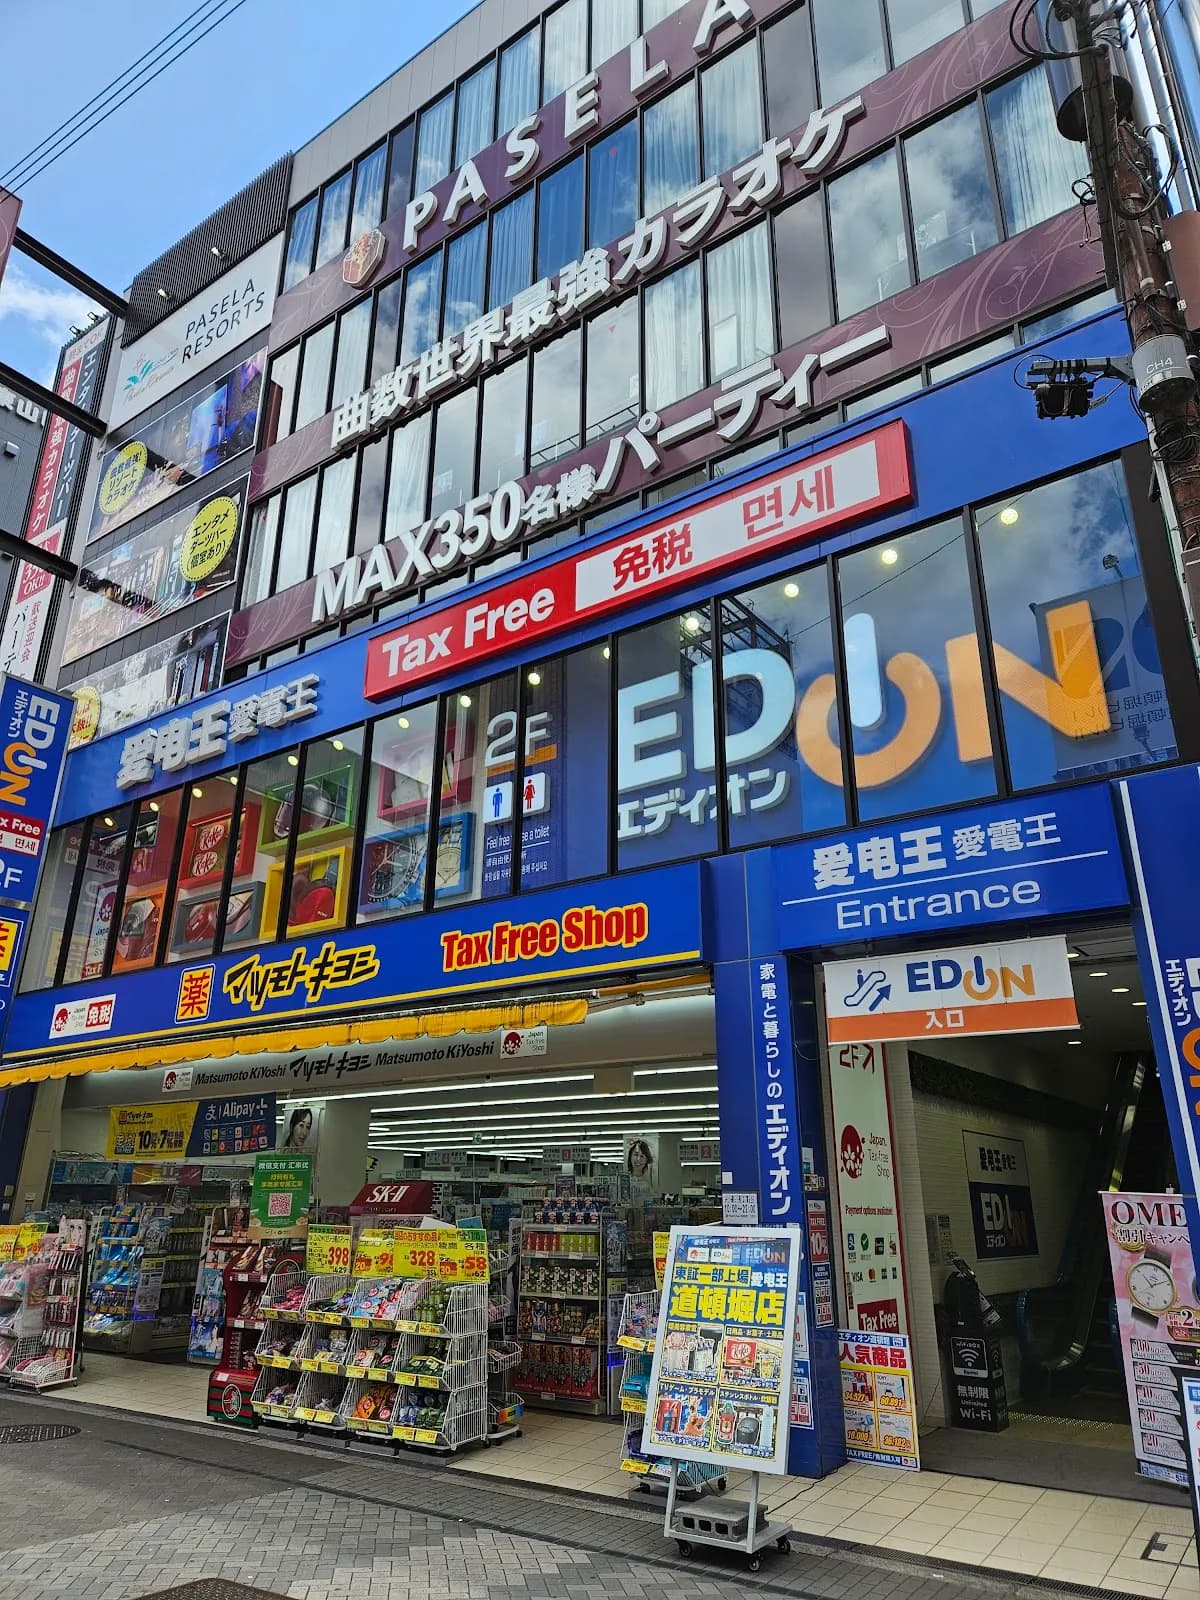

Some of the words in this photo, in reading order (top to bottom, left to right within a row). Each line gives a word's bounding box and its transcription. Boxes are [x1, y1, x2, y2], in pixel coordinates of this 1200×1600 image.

[402, 0, 753, 252] PASELA
[331, 95, 865, 450] 曲数世界最強カラオケ
[182, 291, 264, 364] RESORTS
[186, 278, 254, 340] PASELA
[192, 508, 230, 538] エンタメ
[743, 464, 836, 541] 면세
[613, 522, 693, 591] 免税
[382, 625, 452, 680] Tax
[464, 587, 555, 649] Free
[8, 689, 29, 738] エディオン
[617, 599, 1113, 794] EDION
[485, 711, 549, 768] 2F
[11, 817, 41, 836] Free
[618, 767, 789, 840] エディオン
[813, 825, 947, 891] 爱电王
[952, 811, 1062, 861] 愛電王
[837, 877, 1041, 930] Entrance
[441, 930, 491, 973] Tax
[493, 920, 559, 963] Free
[561, 902, 649, 949] Shop
[181, 972, 210, 1018] 薬
[223, 942, 380, 1012] マツモトキヨシ
[906, 955, 1037, 1001] EDION
[1165, 958, 1192, 1027] エディオン
[86, 1003, 112, 1025] 免税
[925, 1010, 965, 1031] 入口
[195, 1070, 249, 1086] Matsumoto
[249, 1064, 287, 1080] KiYoshi
[290, 1051, 372, 1082] マツモトキヨシ
[375, 1048, 445, 1067] Matsumoto
[446, 1041, 495, 1060] KiYoshi
[845, 1204, 863, 1217] Payment
[328, 1246, 350, 1266] 398
[409, 1250, 435, 1267] 328
[464, 1256, 487, 1270] 58
[674, 1265, 749, 1284] 東証一部上場
[852, 1271, 864, 1283] VISA
[669, 1284, 786, 1326] 道頓堀店
[860, 1313, 879, 1332] Tax
[879, 1310, 898, 1330] Free
[839, 1343, 907, 1369] 人気商品
[960, 1408, 992, 1422] Wi-Fi
